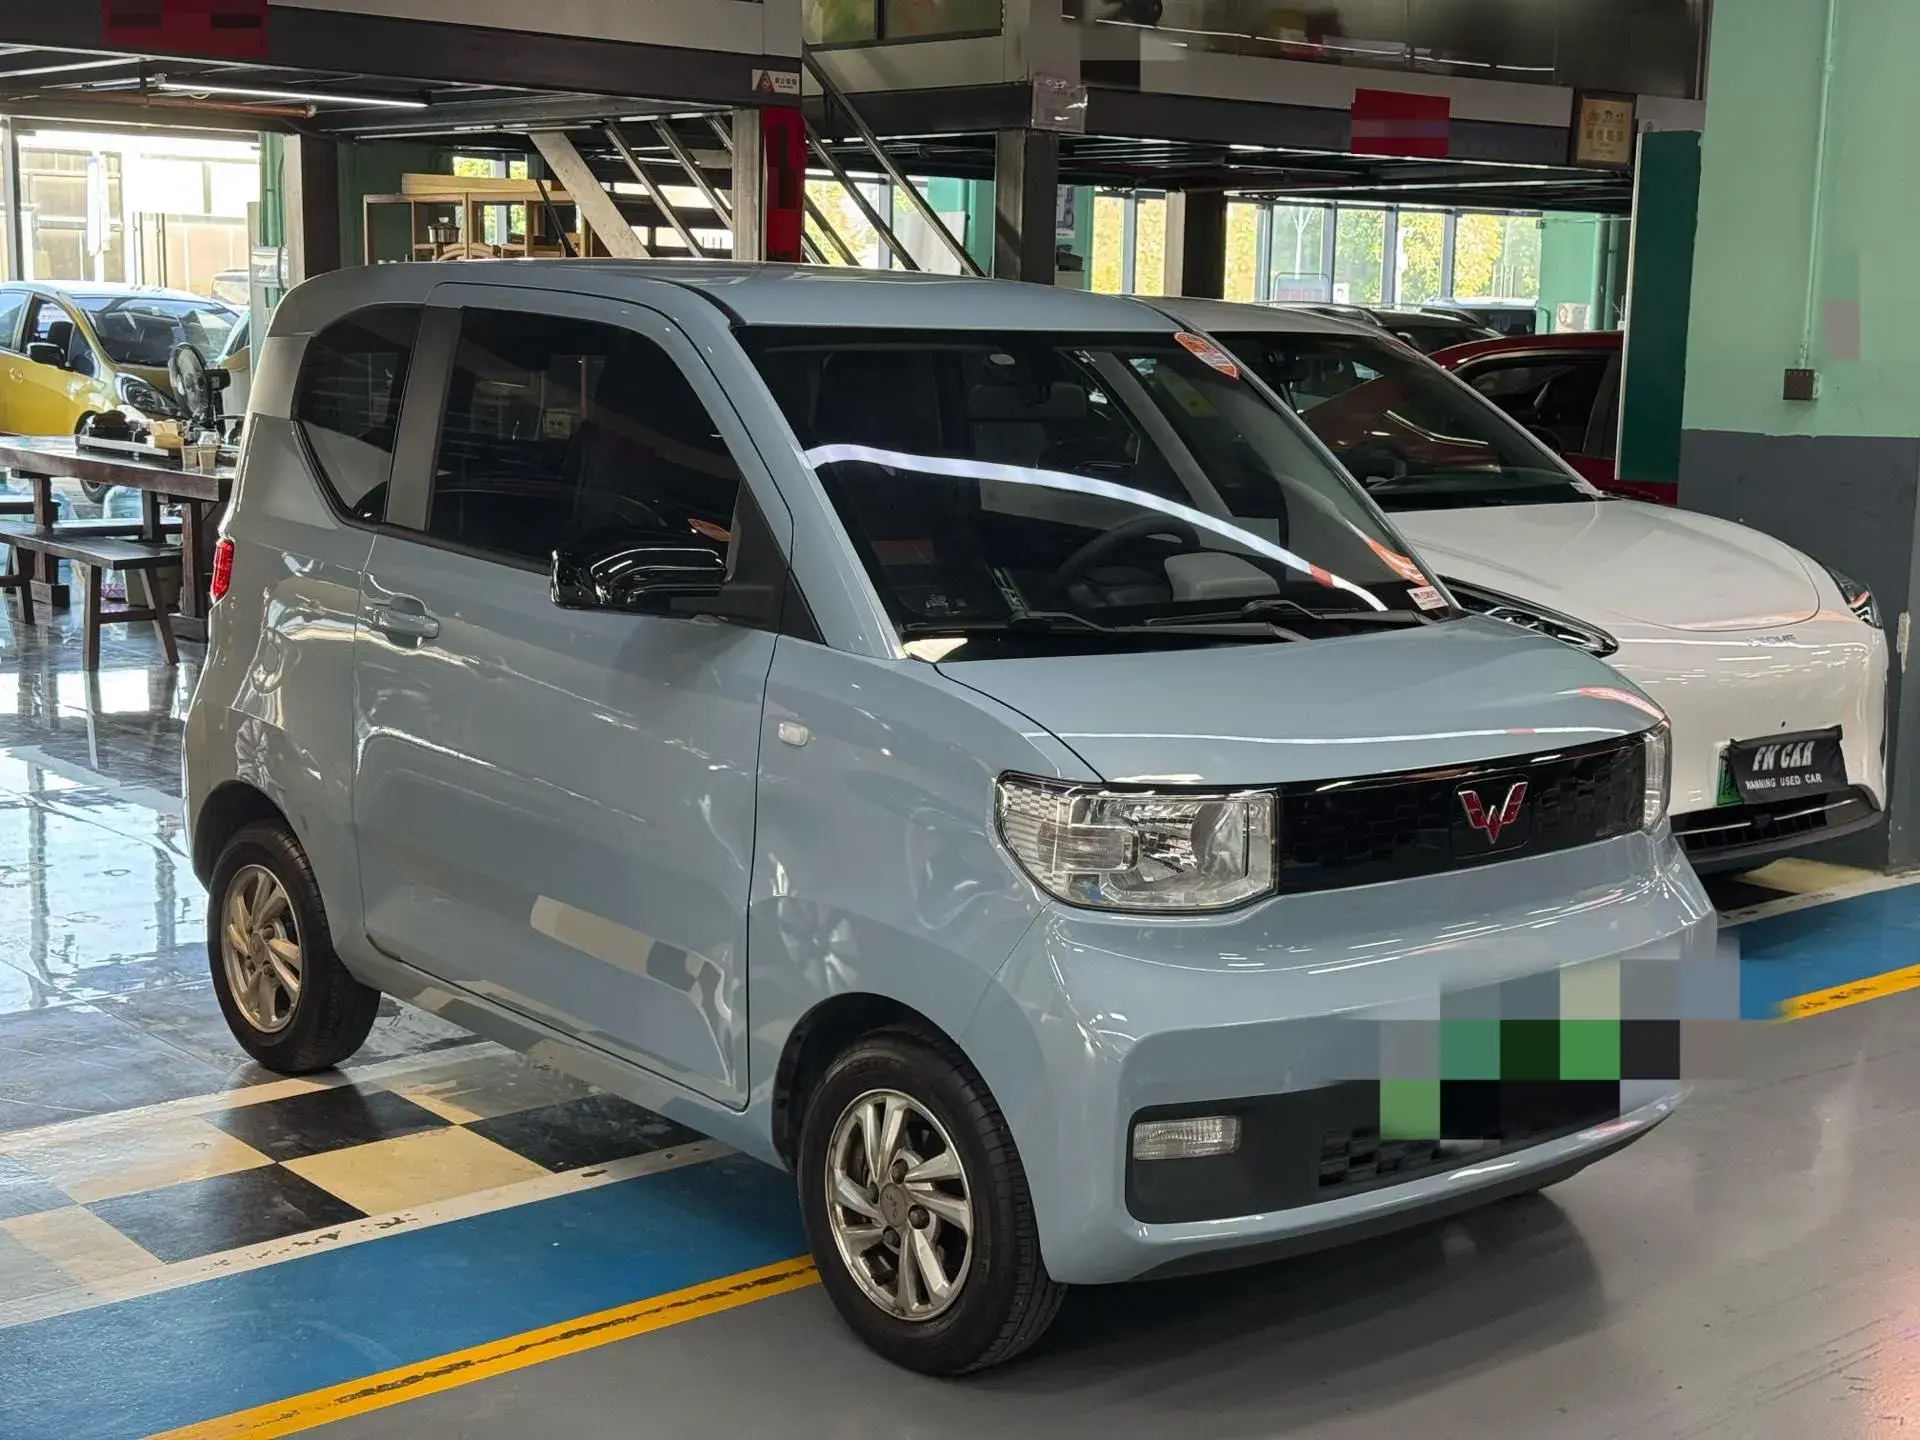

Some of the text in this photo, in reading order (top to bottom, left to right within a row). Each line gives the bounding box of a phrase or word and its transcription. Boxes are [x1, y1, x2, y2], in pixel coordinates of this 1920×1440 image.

[1781, 741, 1815, 768] CAR
[1780, 775, 1801, 787] USED
[1805, 773, 1822, 784] CAR
